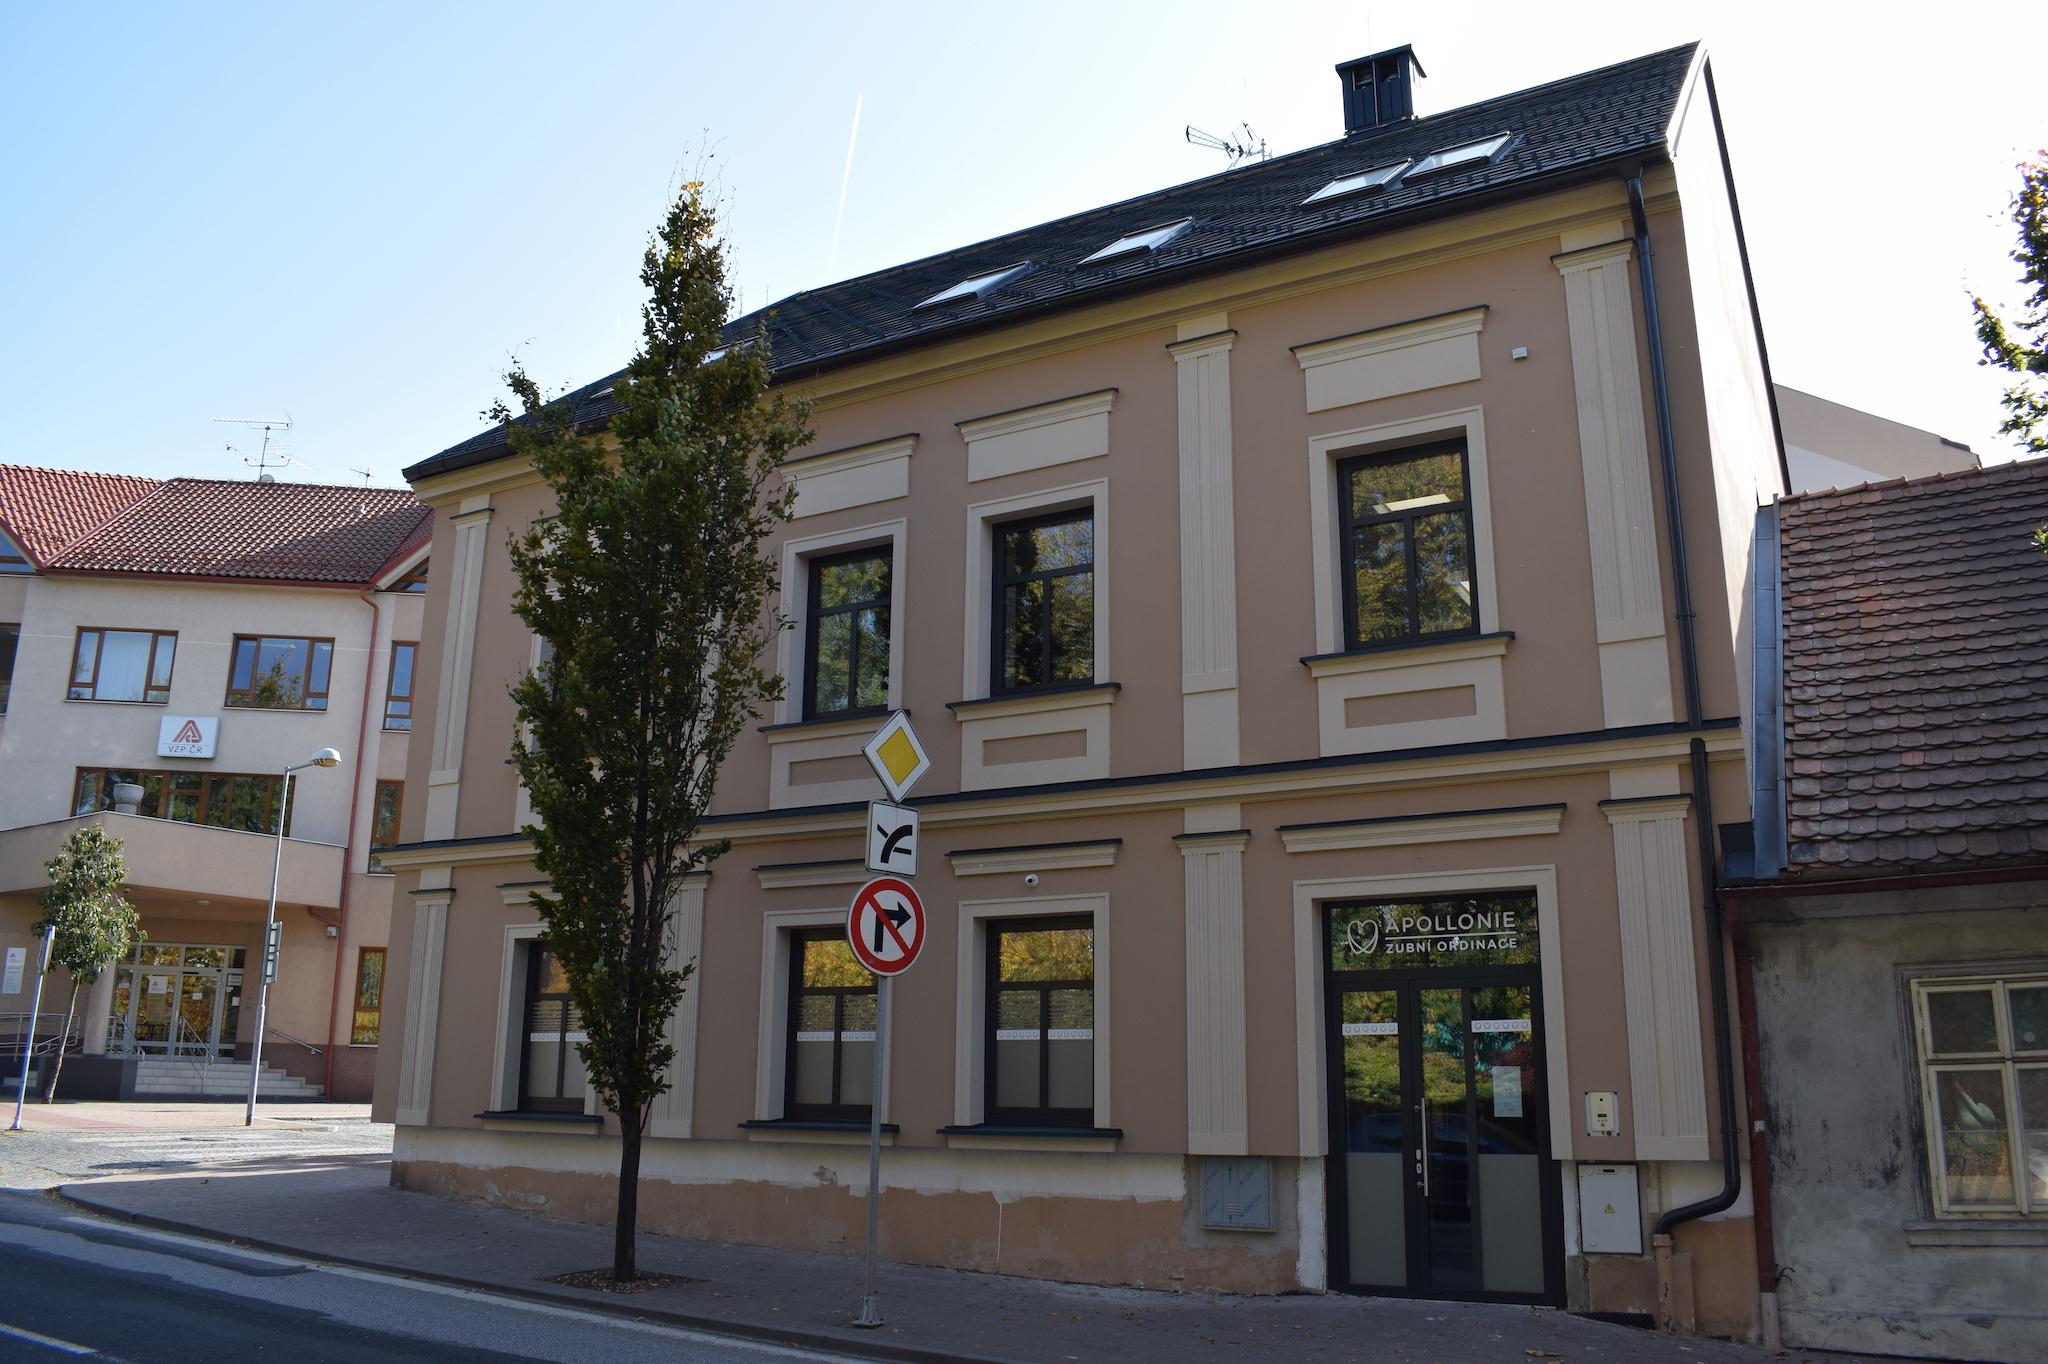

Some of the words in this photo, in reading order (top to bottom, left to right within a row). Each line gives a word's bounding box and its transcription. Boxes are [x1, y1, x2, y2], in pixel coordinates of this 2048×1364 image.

[168, 745, 186, 753] VZP
[189, 745, 203, 754] ČR
[1385, 911, 1516, 934] APOLLONIE
[1385, 939, 1431, 954] ZUBNÍ
[1437, 938, 1517, 952] ORDINACE
